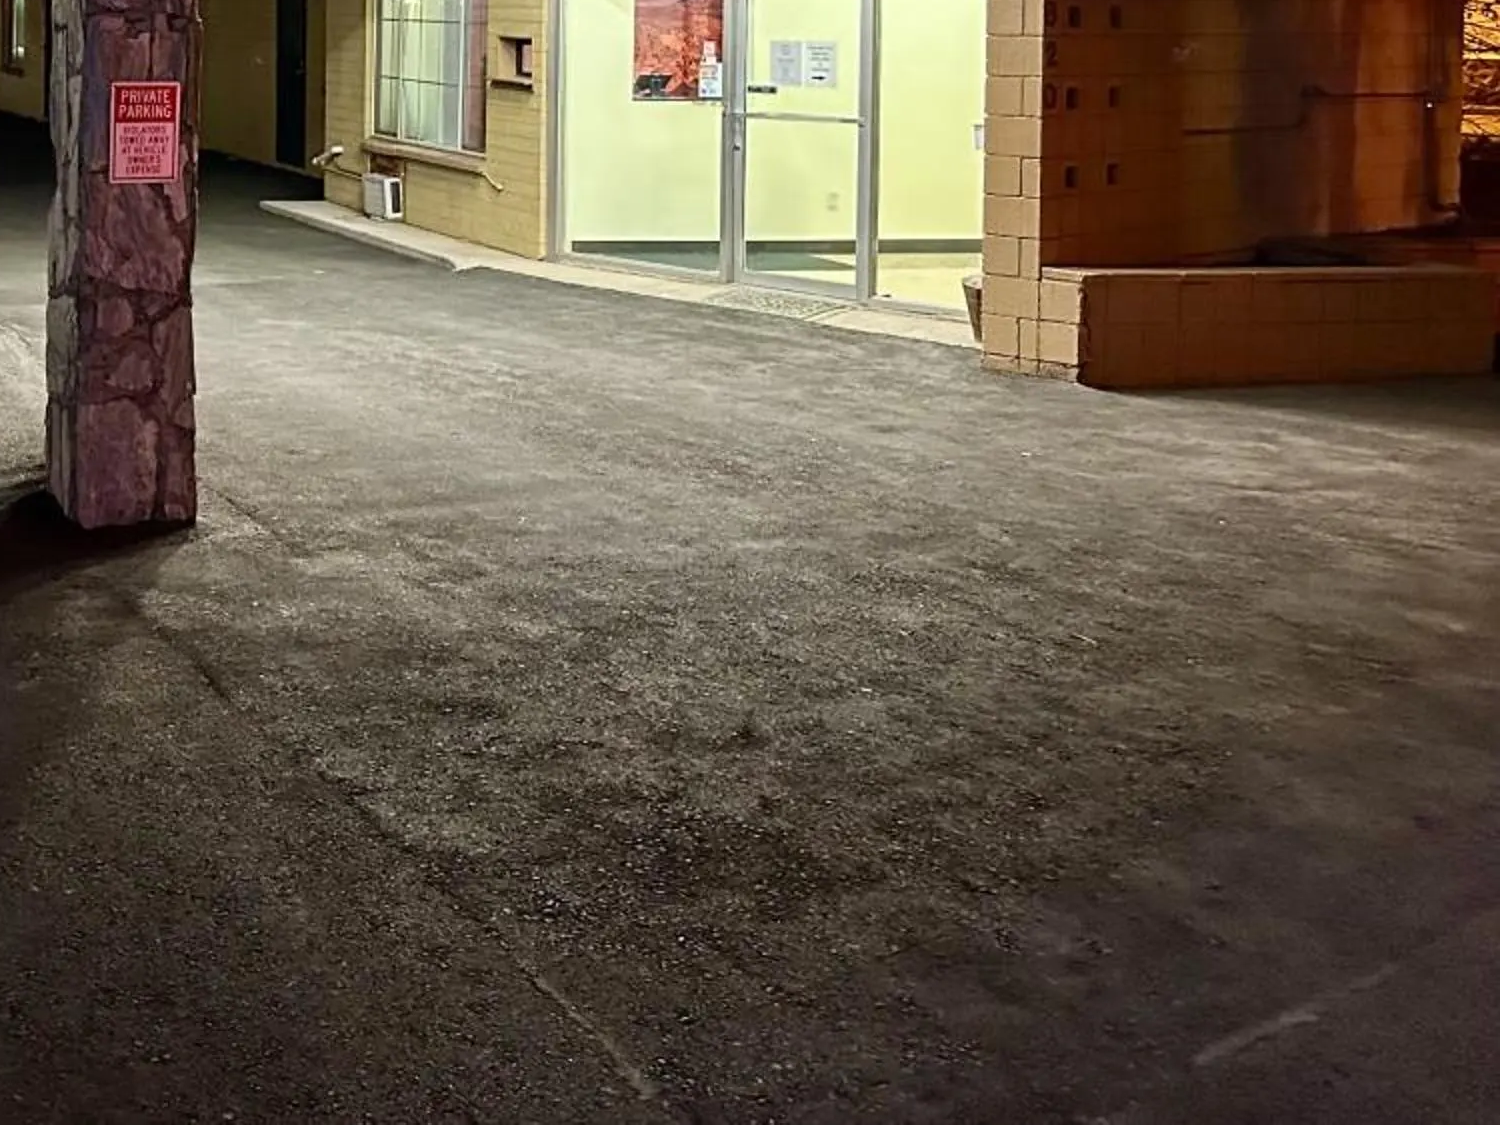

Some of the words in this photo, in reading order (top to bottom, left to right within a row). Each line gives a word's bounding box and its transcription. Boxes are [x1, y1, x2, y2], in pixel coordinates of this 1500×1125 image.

[121, 90, 171, 104] PRIVATE
[119, 104, 172, 118] PARKING
[148, 136, 170, 144] AWAY
[122, 146, 132, 154] AT
